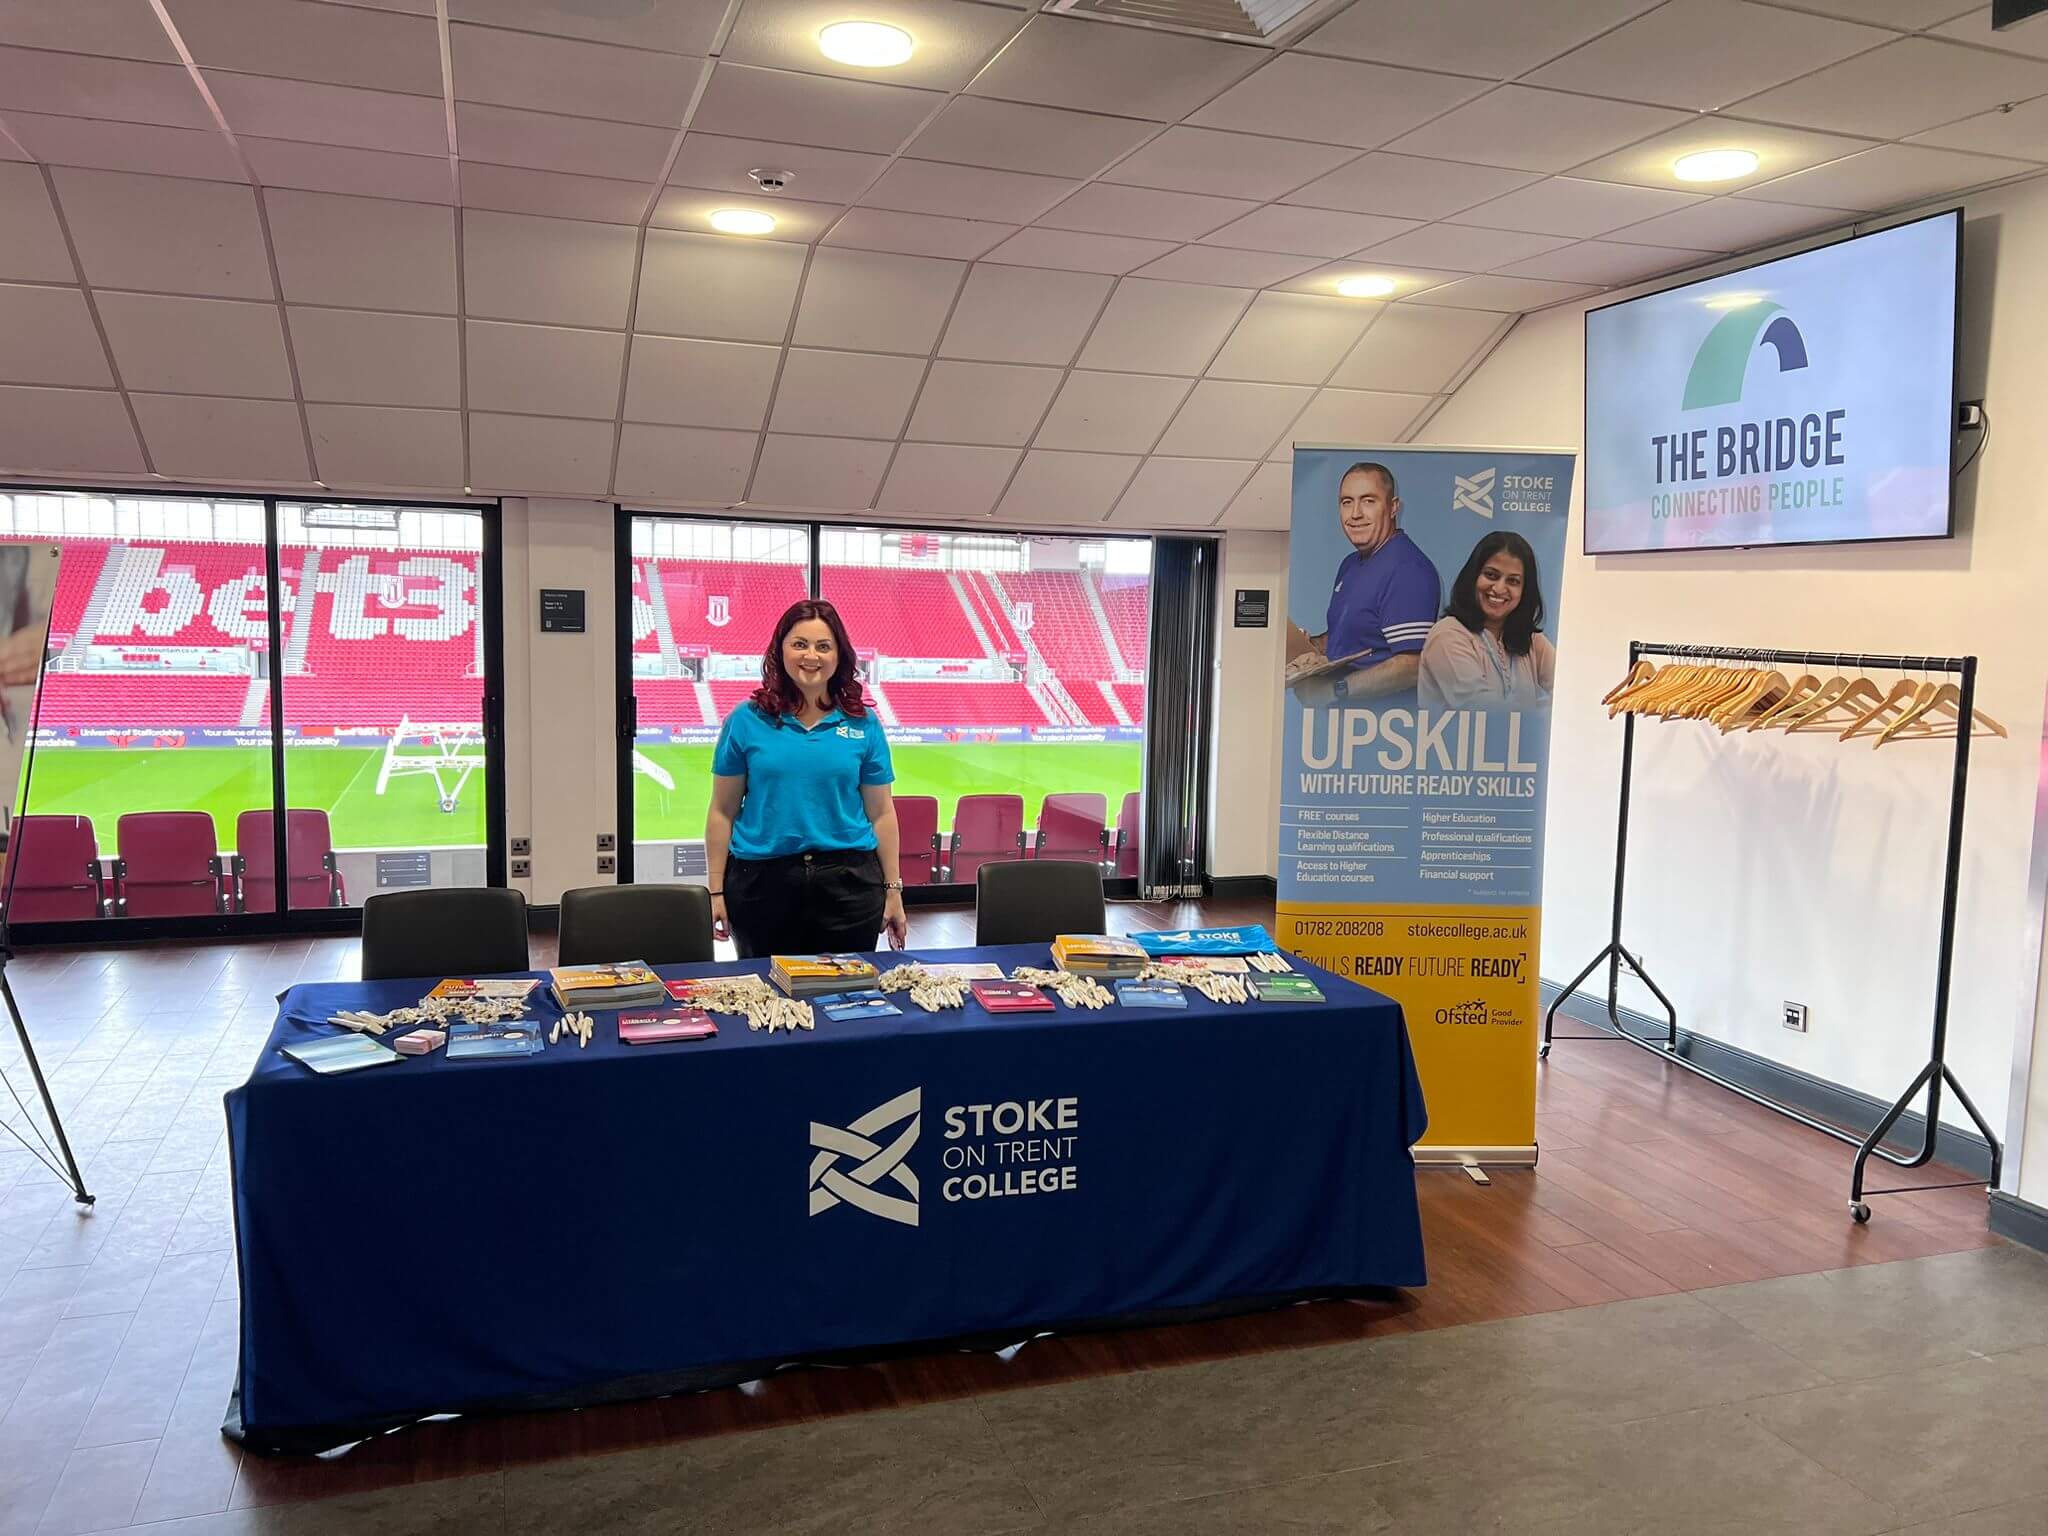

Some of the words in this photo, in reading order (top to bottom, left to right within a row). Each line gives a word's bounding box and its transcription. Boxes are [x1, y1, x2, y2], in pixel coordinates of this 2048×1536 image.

[1652, 430, 1708, 484] THE
[1716, 408, 1846, 478] BRIDGE
[1503, 475, 1553, 490] STOKE
[1502, 490, 1519, 500] ON
[1521, 491, 1552, 501] TRENT
[1651, 484, 1761, 520] CONNECTING
[1767, 477, 1844, 511] PEOPLE
[1502, 501, 1551, 513] COLLEGE
[1301, 707, 1537, 773] UPSKILL
[1300, 773, 1345, 794] WITH
[1350, 774, 1414, 795] FUTURE
[1416, 776, 1474, 796] READY
[1476, 777, 1537, 798] SKILLS
[1325, 812, 1360, 821] courses
[1422, 812, 1450, 824] Higher
[1452, 813, 1497, 823] Education
[1298, 829, 1332, 840] Flexible
[1333, 831, 1369, 840] Distance
[1422, 831, 1474, 842] Professional
[1475, 832, 1533, 844] qualifications
[1297, 842, 1336, 853] Learning
[1336, 842, 1395, 853] qualifications
[1420, 850, 1492, 862] Apprenticeships
[1296, 860, 1328, 870] Access
[1329, 861, 1339, 870] to
[1339, 861, 1368, 872] Higher
[1296, 872, 1340, 882] Education
[1340, 874, 1375, 883] courses
[1419, 869, 1459, 880] Financial
[1459, 871, 1495, 882] support
[1295, 921, 1331, 936] 01782
[1335, 921, 1384, 937] 208208
[1407, 922, 1528, 941] stokecollege.ac.uk
[1355, 956, 1404, 976] READY
[1409, 957, 1465, 977] FUTURE
[1470, 958, 1520, 978] READY
[1435, 1006, 1488, 1025] Ofsted
[1491, 1009, 1512, 1017] Good
[1491, 1017, 1523, 1026] Provider
[943, 1096, 1079, 1140] STOKE
[942, 1146, 986, 1170] ON
[993, 1136, 1079, 1165] TRENT
[942, 1166, 1078, 1203] COLLEGE
